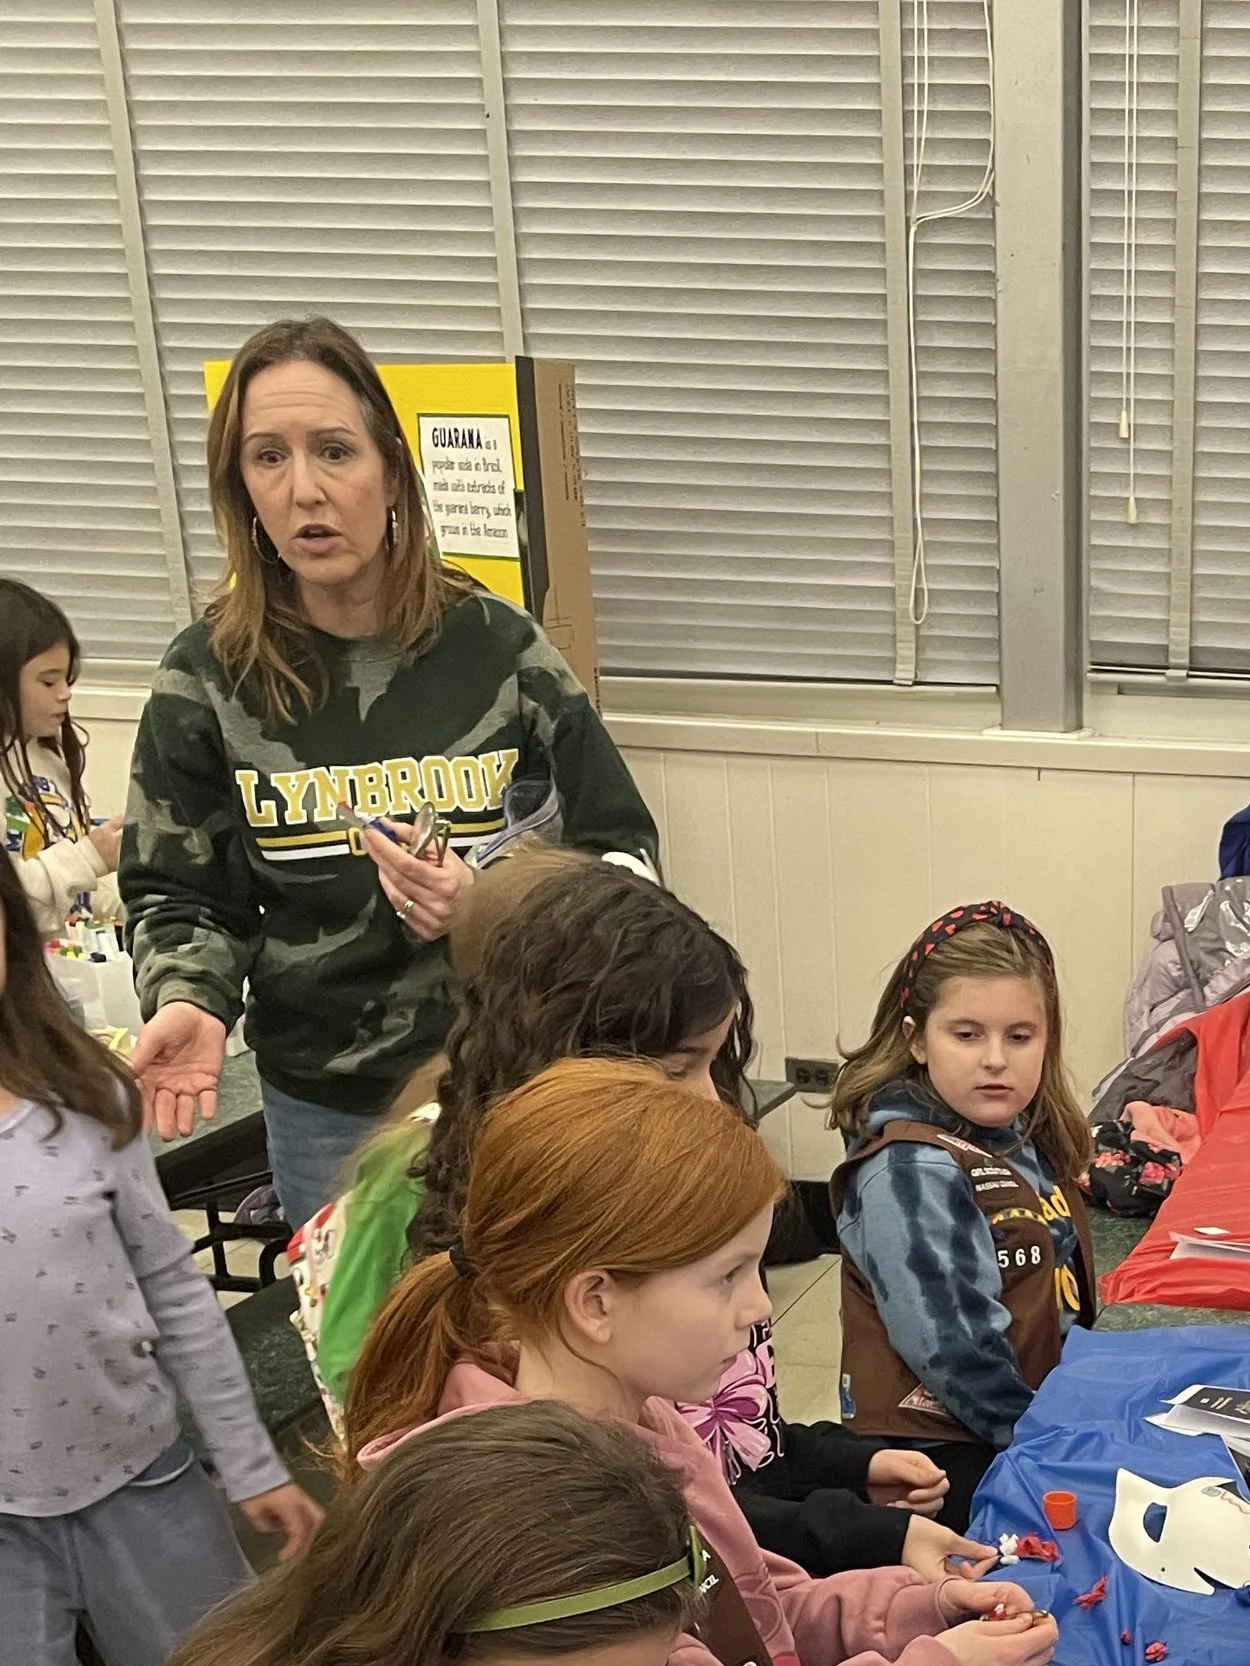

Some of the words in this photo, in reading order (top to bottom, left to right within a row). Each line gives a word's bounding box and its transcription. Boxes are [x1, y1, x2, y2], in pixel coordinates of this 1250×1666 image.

[432, 427, 483, 449] GUARANA
[467, 480, 497, 495] extracts
[235, 748, 519, 827] LYNBROOK
